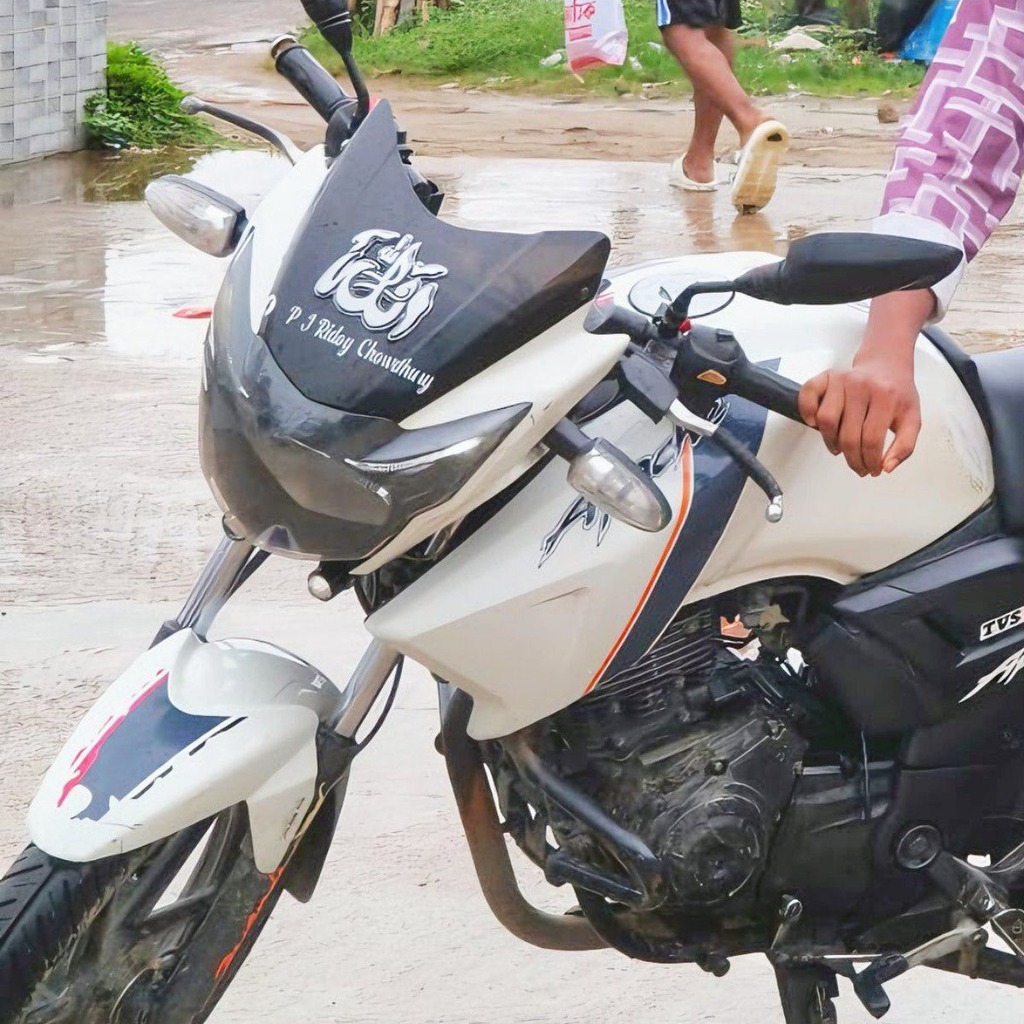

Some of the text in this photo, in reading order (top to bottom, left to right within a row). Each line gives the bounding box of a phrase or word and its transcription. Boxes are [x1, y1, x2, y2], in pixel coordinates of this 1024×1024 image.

[285, 305, 300, 325] P
[315, 318, 355, 356] Ridoy
[983, 608, 1023, 636] TVS
